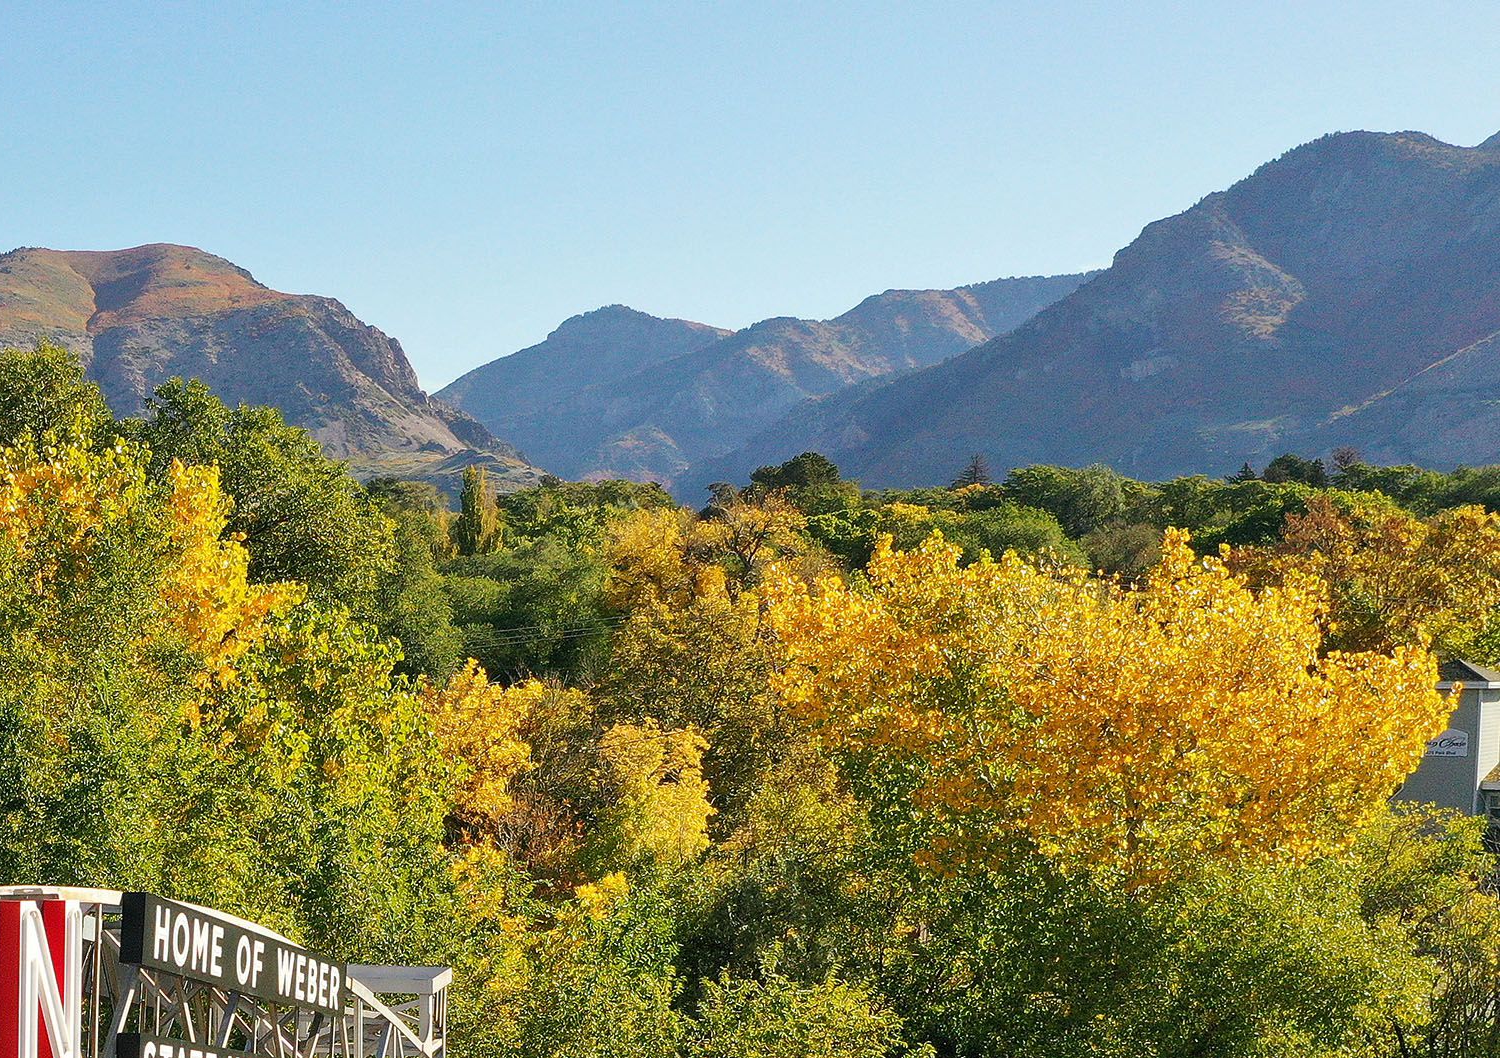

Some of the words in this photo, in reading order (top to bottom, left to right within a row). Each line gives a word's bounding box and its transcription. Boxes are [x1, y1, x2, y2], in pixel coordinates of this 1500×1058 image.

[153, 905, 225, 978] HOME
[236, 935, 265, 988] OF
[277, 947, 341, 1011] WEBER
